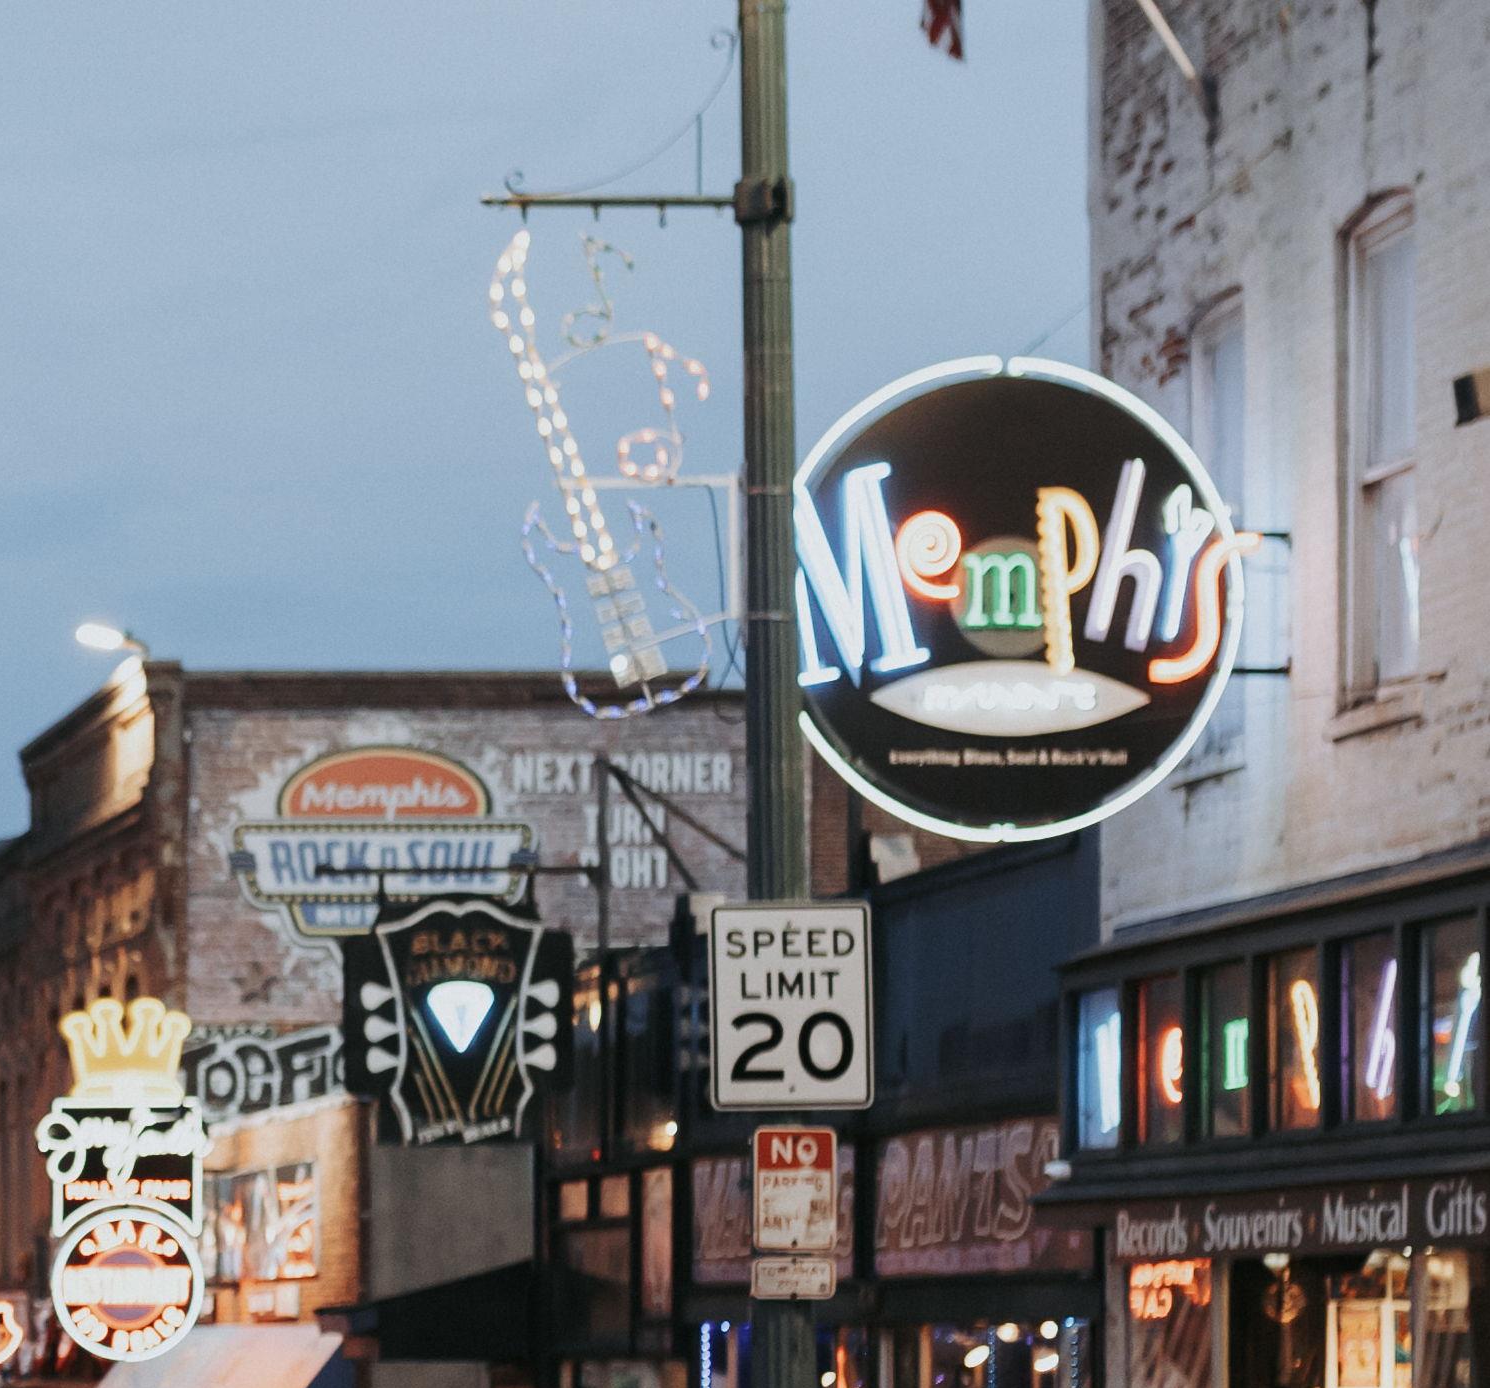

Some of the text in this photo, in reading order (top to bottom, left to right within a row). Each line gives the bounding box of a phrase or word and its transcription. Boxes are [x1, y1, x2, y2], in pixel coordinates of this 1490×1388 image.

[794, 457, 1262, 690] Memphis
[513, 752, 595, 794] NEXT
[301, 777, 469, 821] Memphis
[269, 841, 369, 884] ROCK
[406, 841, 496, 884] SOUL
[579, 851, 668, 888] RGHT
[412, 931, 506, 954] BLACK
[726, 929, 855, 958] SPEED
[739, 969, 842, 1001] LIMIT
[730, 1012, 854, 1082] 20
[771, 1137, 819, 1165] NO
[1117, 1178, 1488, 1256] Records Souvenirs Musical Gifts
